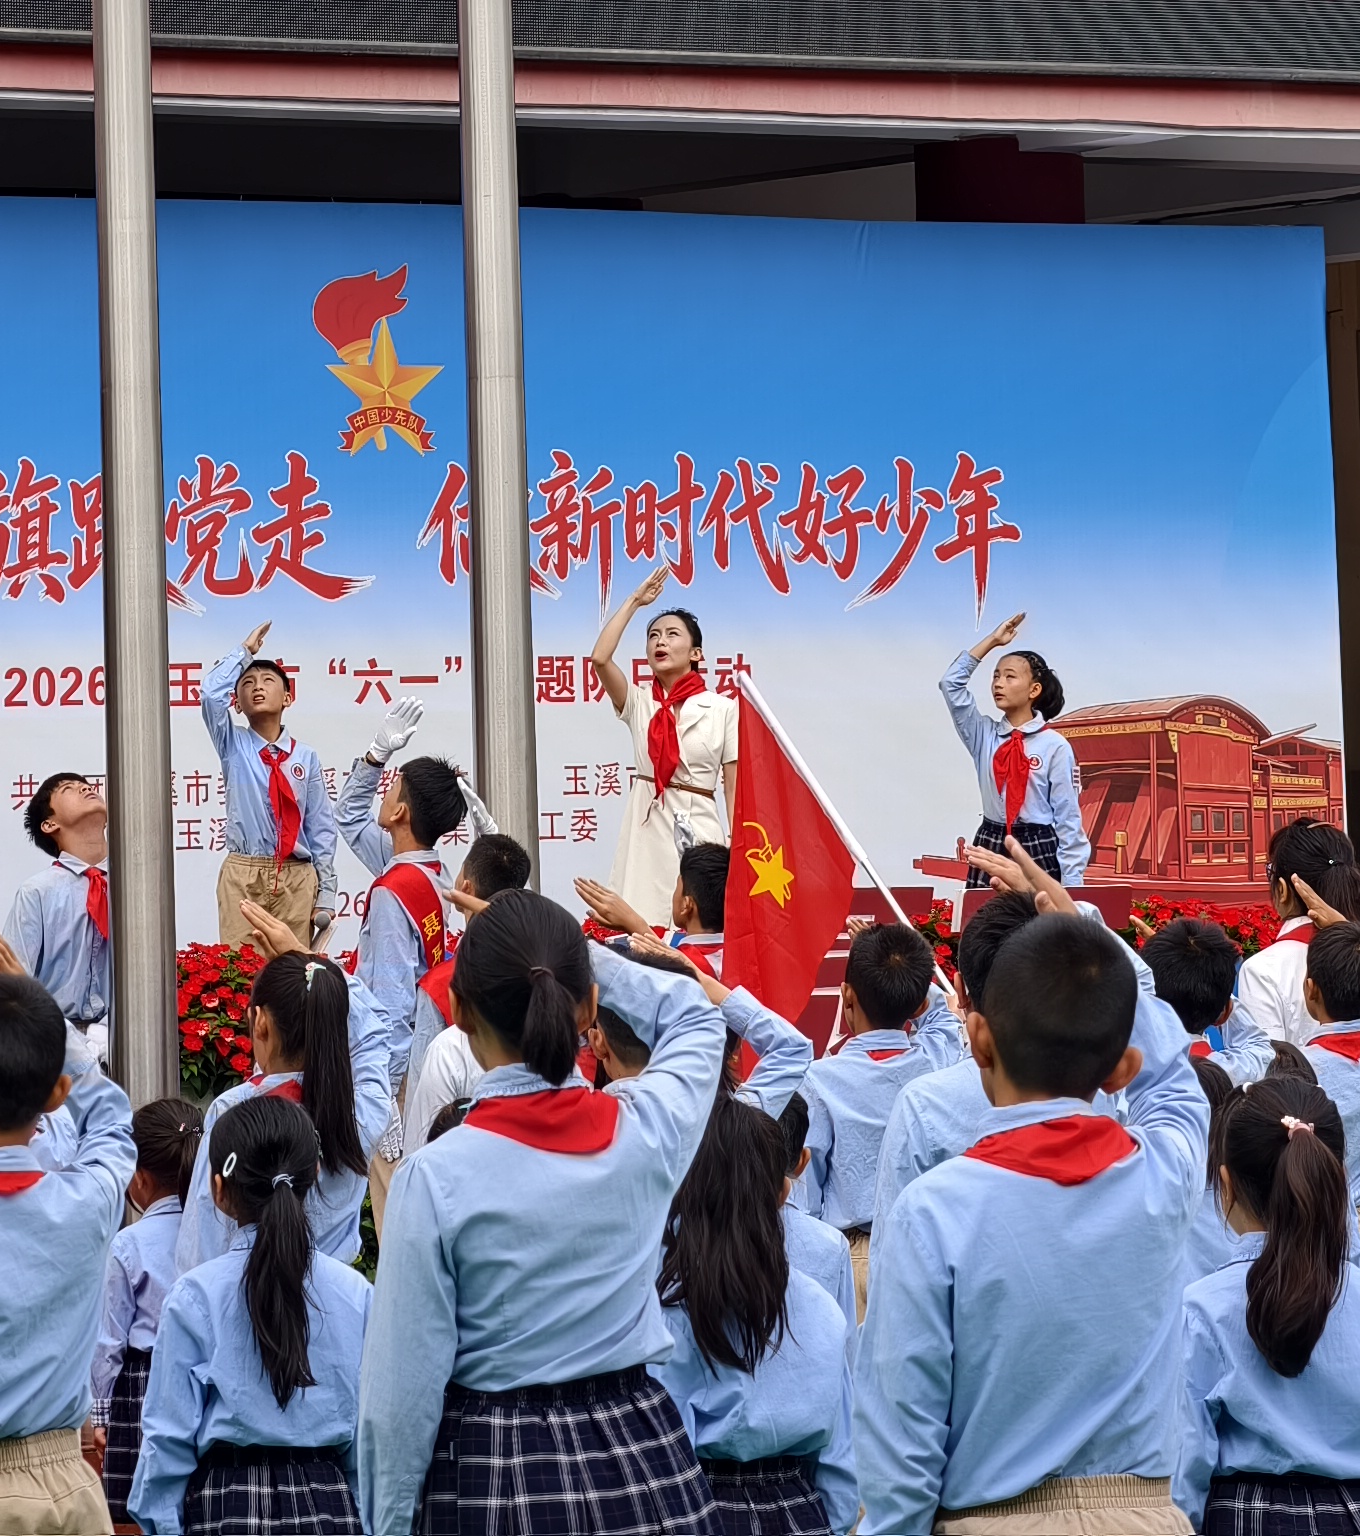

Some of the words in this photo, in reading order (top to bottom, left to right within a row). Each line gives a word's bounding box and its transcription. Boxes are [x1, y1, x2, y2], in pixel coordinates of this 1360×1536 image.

[353, 407, 419, 433] 中国少先队
